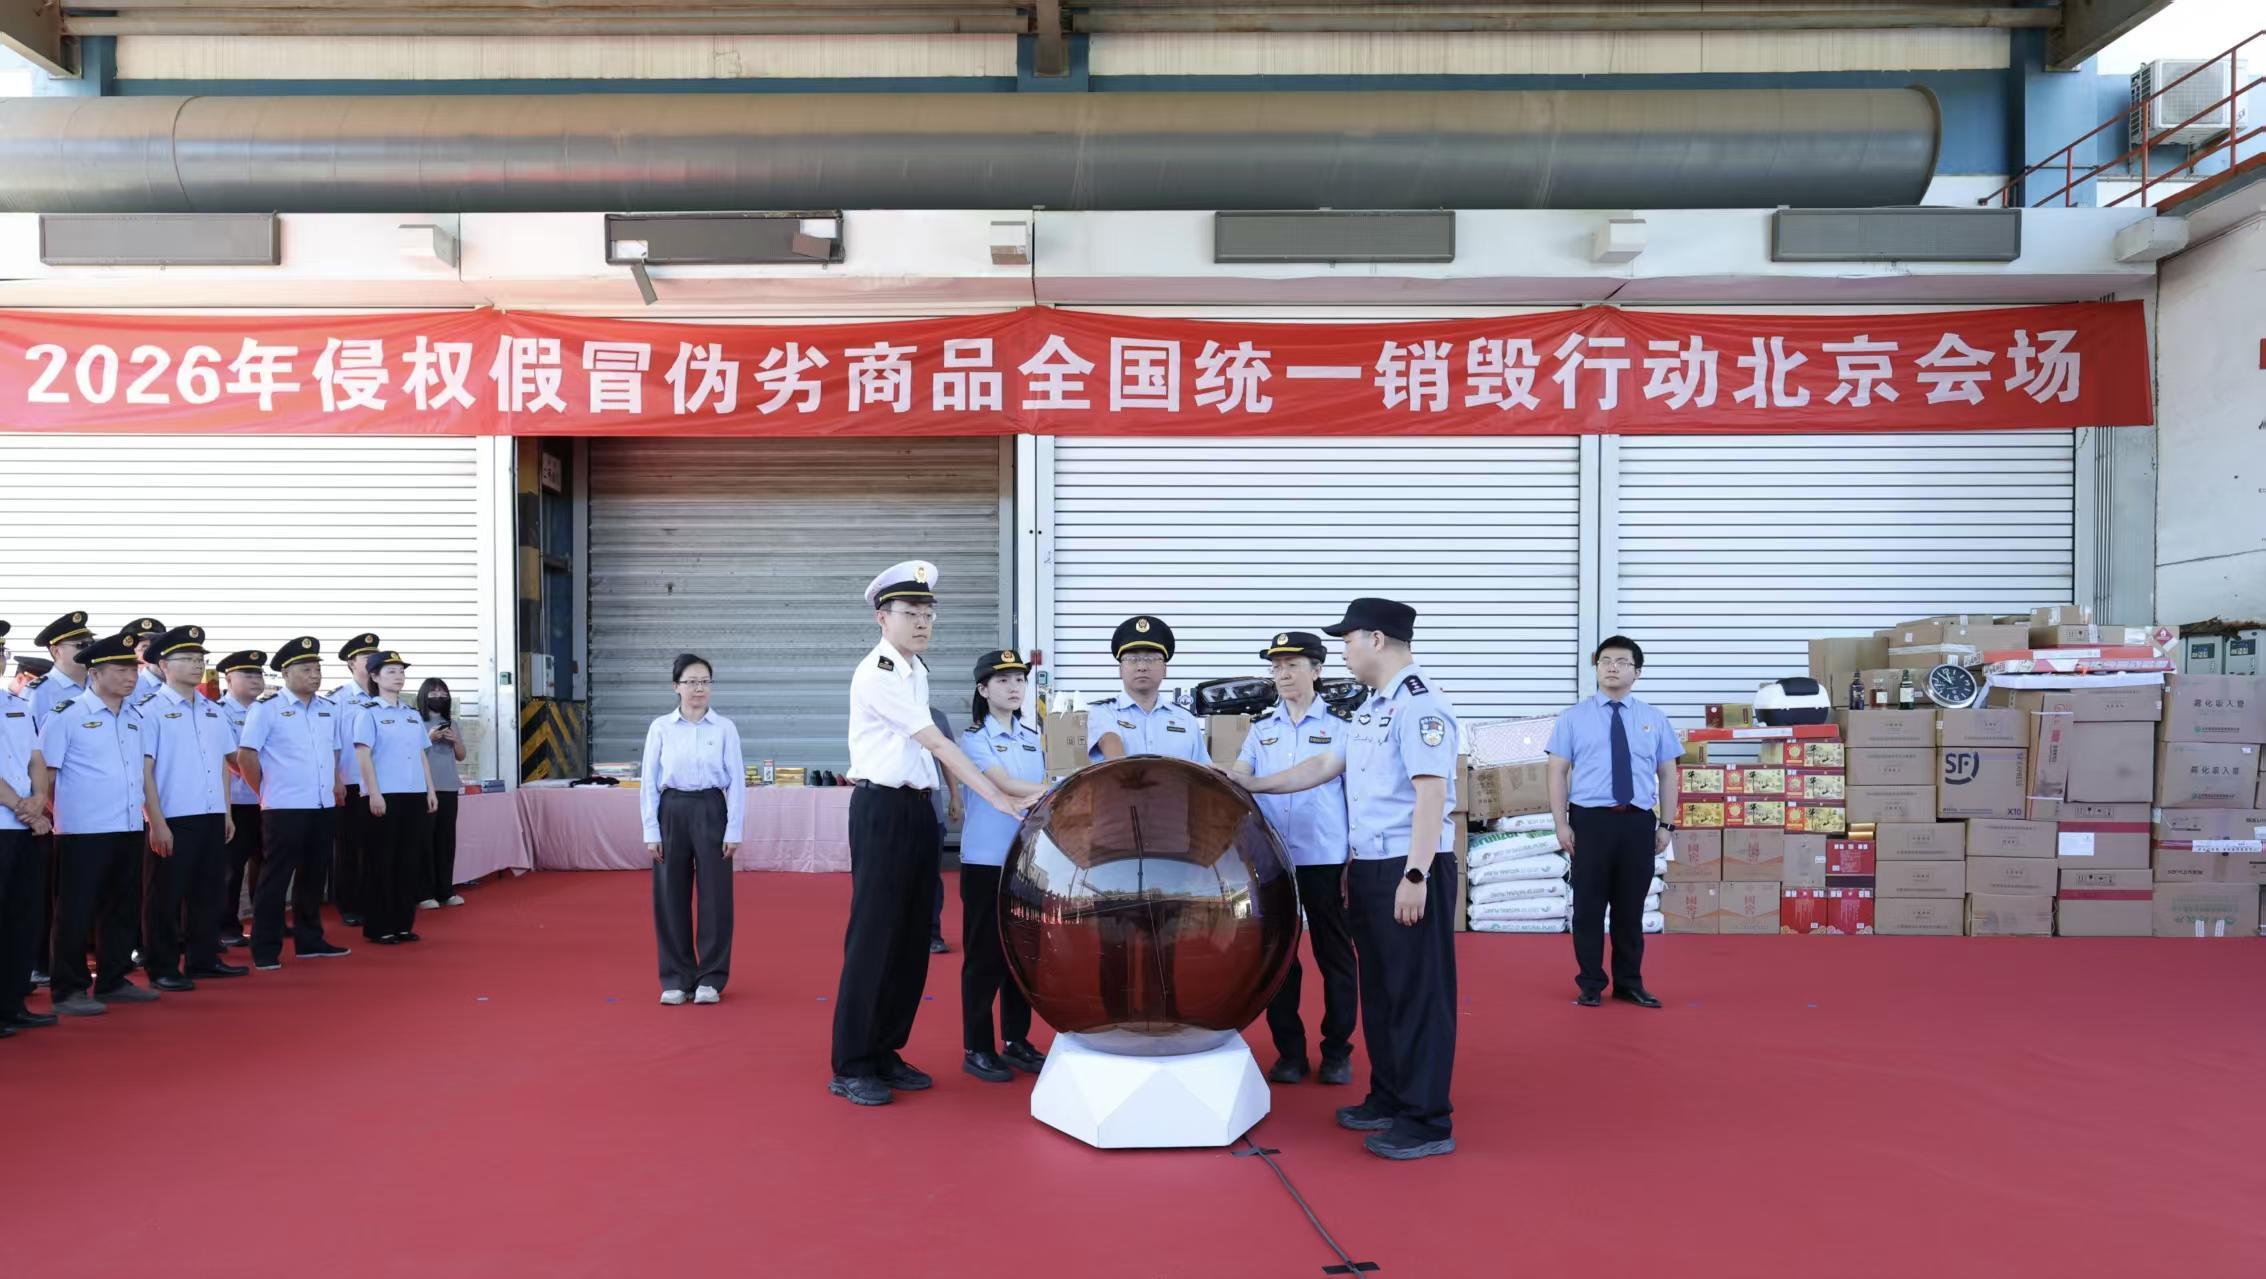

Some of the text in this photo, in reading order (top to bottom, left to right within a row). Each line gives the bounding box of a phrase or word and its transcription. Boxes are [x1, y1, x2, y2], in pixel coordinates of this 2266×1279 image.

[25, 329, 2081, 415] 2026年侵权假冒伪劣商品全国统一销毁行动北京会场
[2008, 808, 2022, 816] X10
